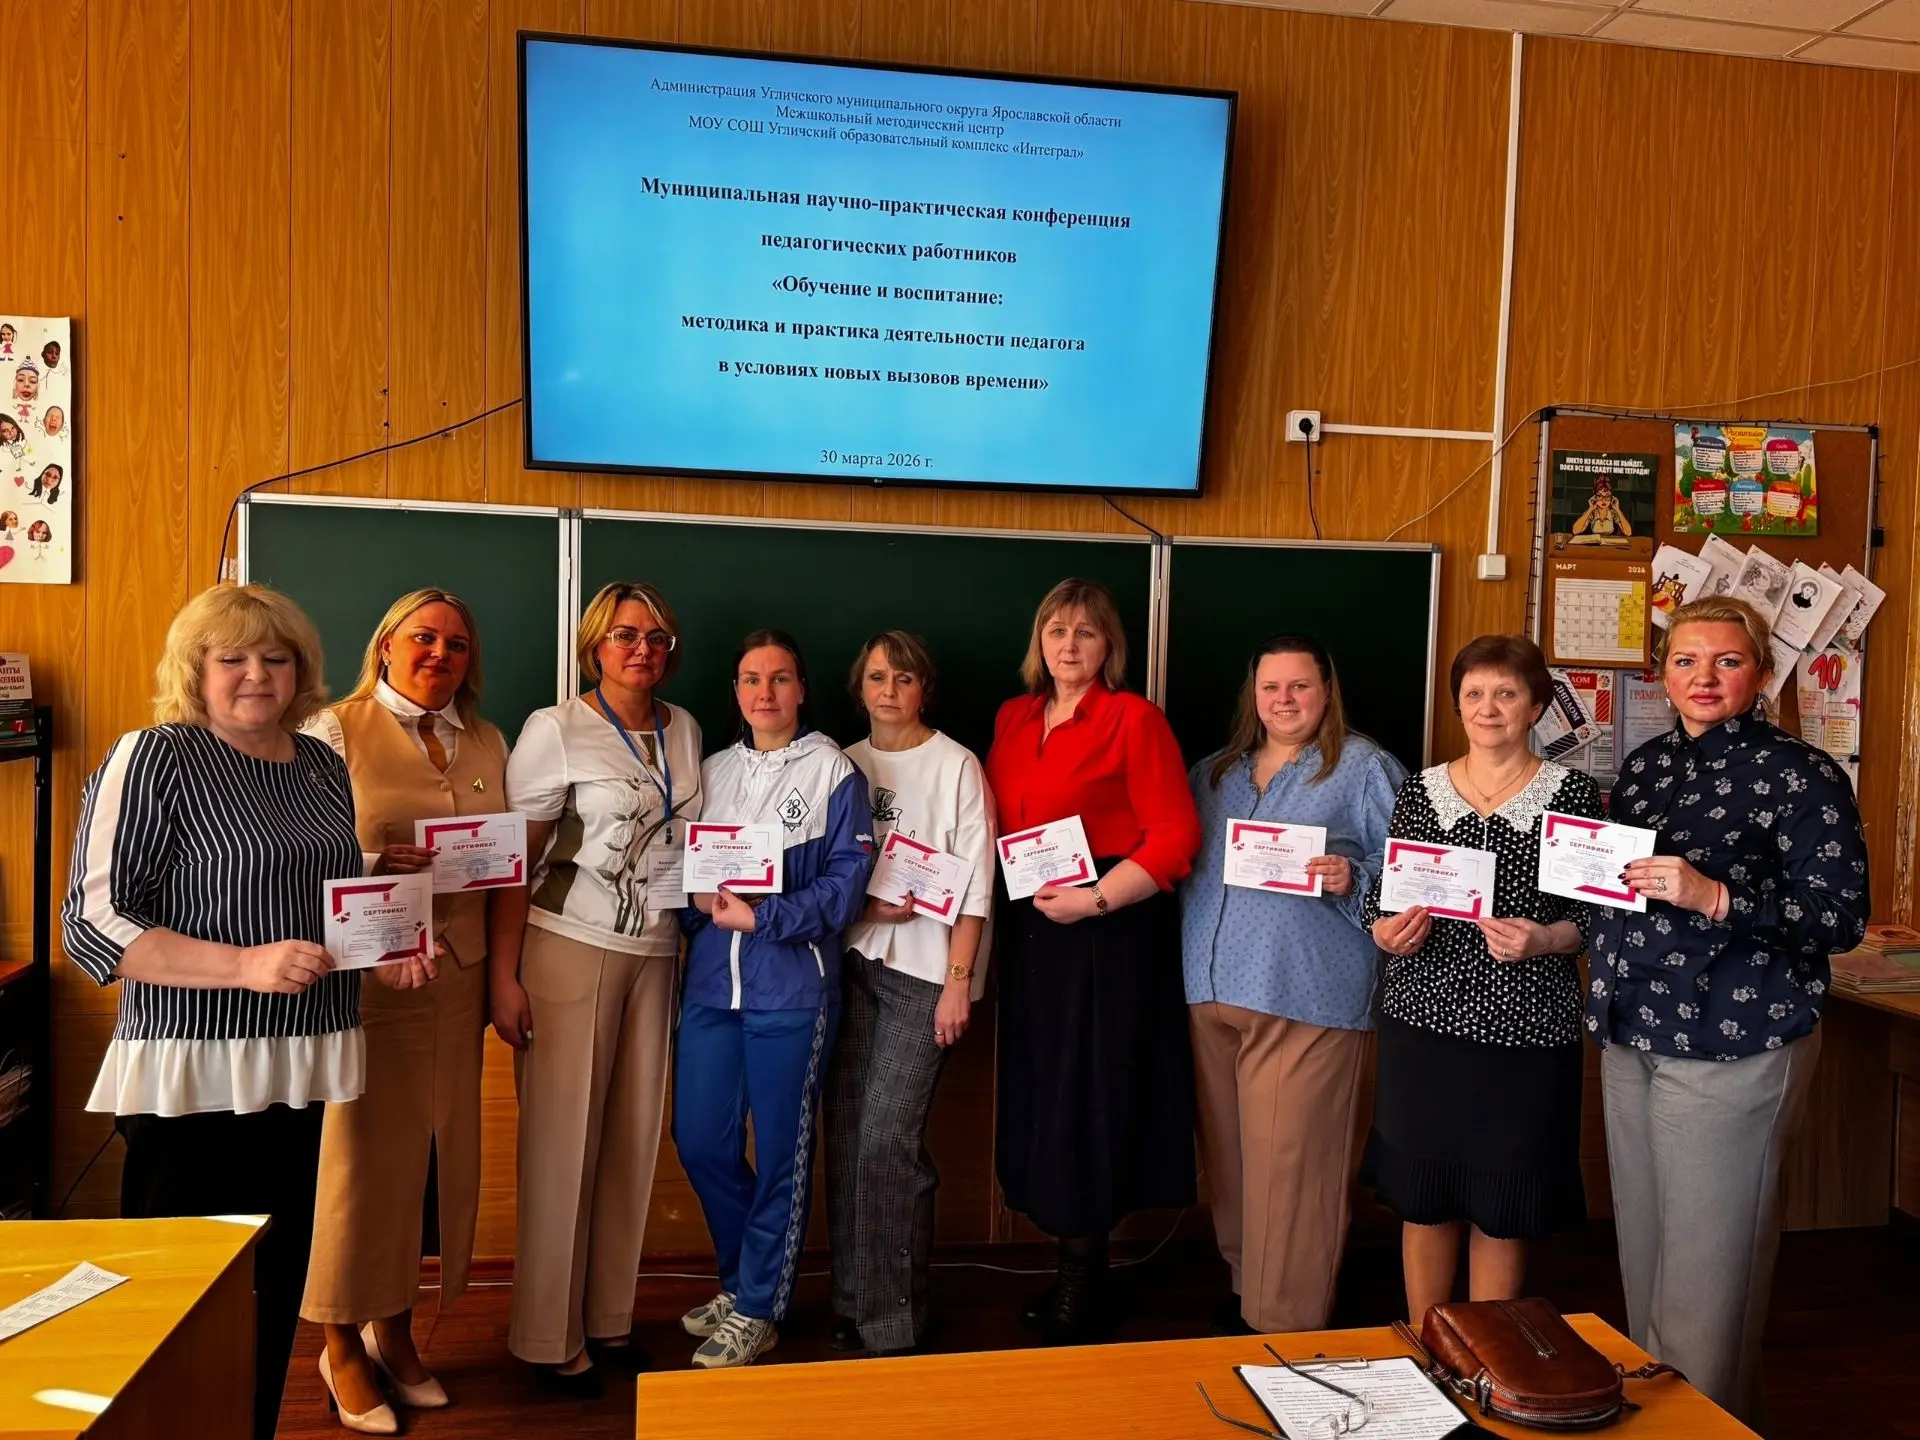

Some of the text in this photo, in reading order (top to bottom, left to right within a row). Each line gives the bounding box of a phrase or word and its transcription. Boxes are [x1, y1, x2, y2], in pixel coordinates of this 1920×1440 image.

[650, 78, 1122, 128] Администрация Угличского муниципального округа Ярославской области
[776, 105, 1004, 138] Межшкольный методический центр
[689, 115, 1084, 159] МОУ СОШ Угличский образовательный комплекс «Интеграл»
[640, 177, 1131, 229] Муниципальная научно-практическая конференция
[761, 233, 1017, 264] педагогических работников
[772, 275, 1003, 305] «Обучение и воспитание:
[681, 315, 1085, 351] методика и практика деятельности педагога
[718, 360, 1049, 390] в условиях новых вызовов времени»
[820, 449, 933, 468] 30 марта 2026 г.
[1556, 563, 1576, 571] МАРТ
[1571, 676, 1590, 685] ЛОМ
[1808, 653, 1842, 690] 10
[1554, 684, 1581, 721] ДИПЛОМ
[1630, 689, 1662, 701] ГРАМОТ
[15, 720, 23, 732] 7
[452, 841, 497, 851] СЕРТИФИКАТ
[1569, 841, 1614, 855] СЕРТИФИКАТ
[904, 858, 941, 876] СЕРТИФИКАТ
[1413, 866, 1459, 878] СЕРТИФИКАТ
[363, 906, 408, 916] СЕРТИФИКАТ
